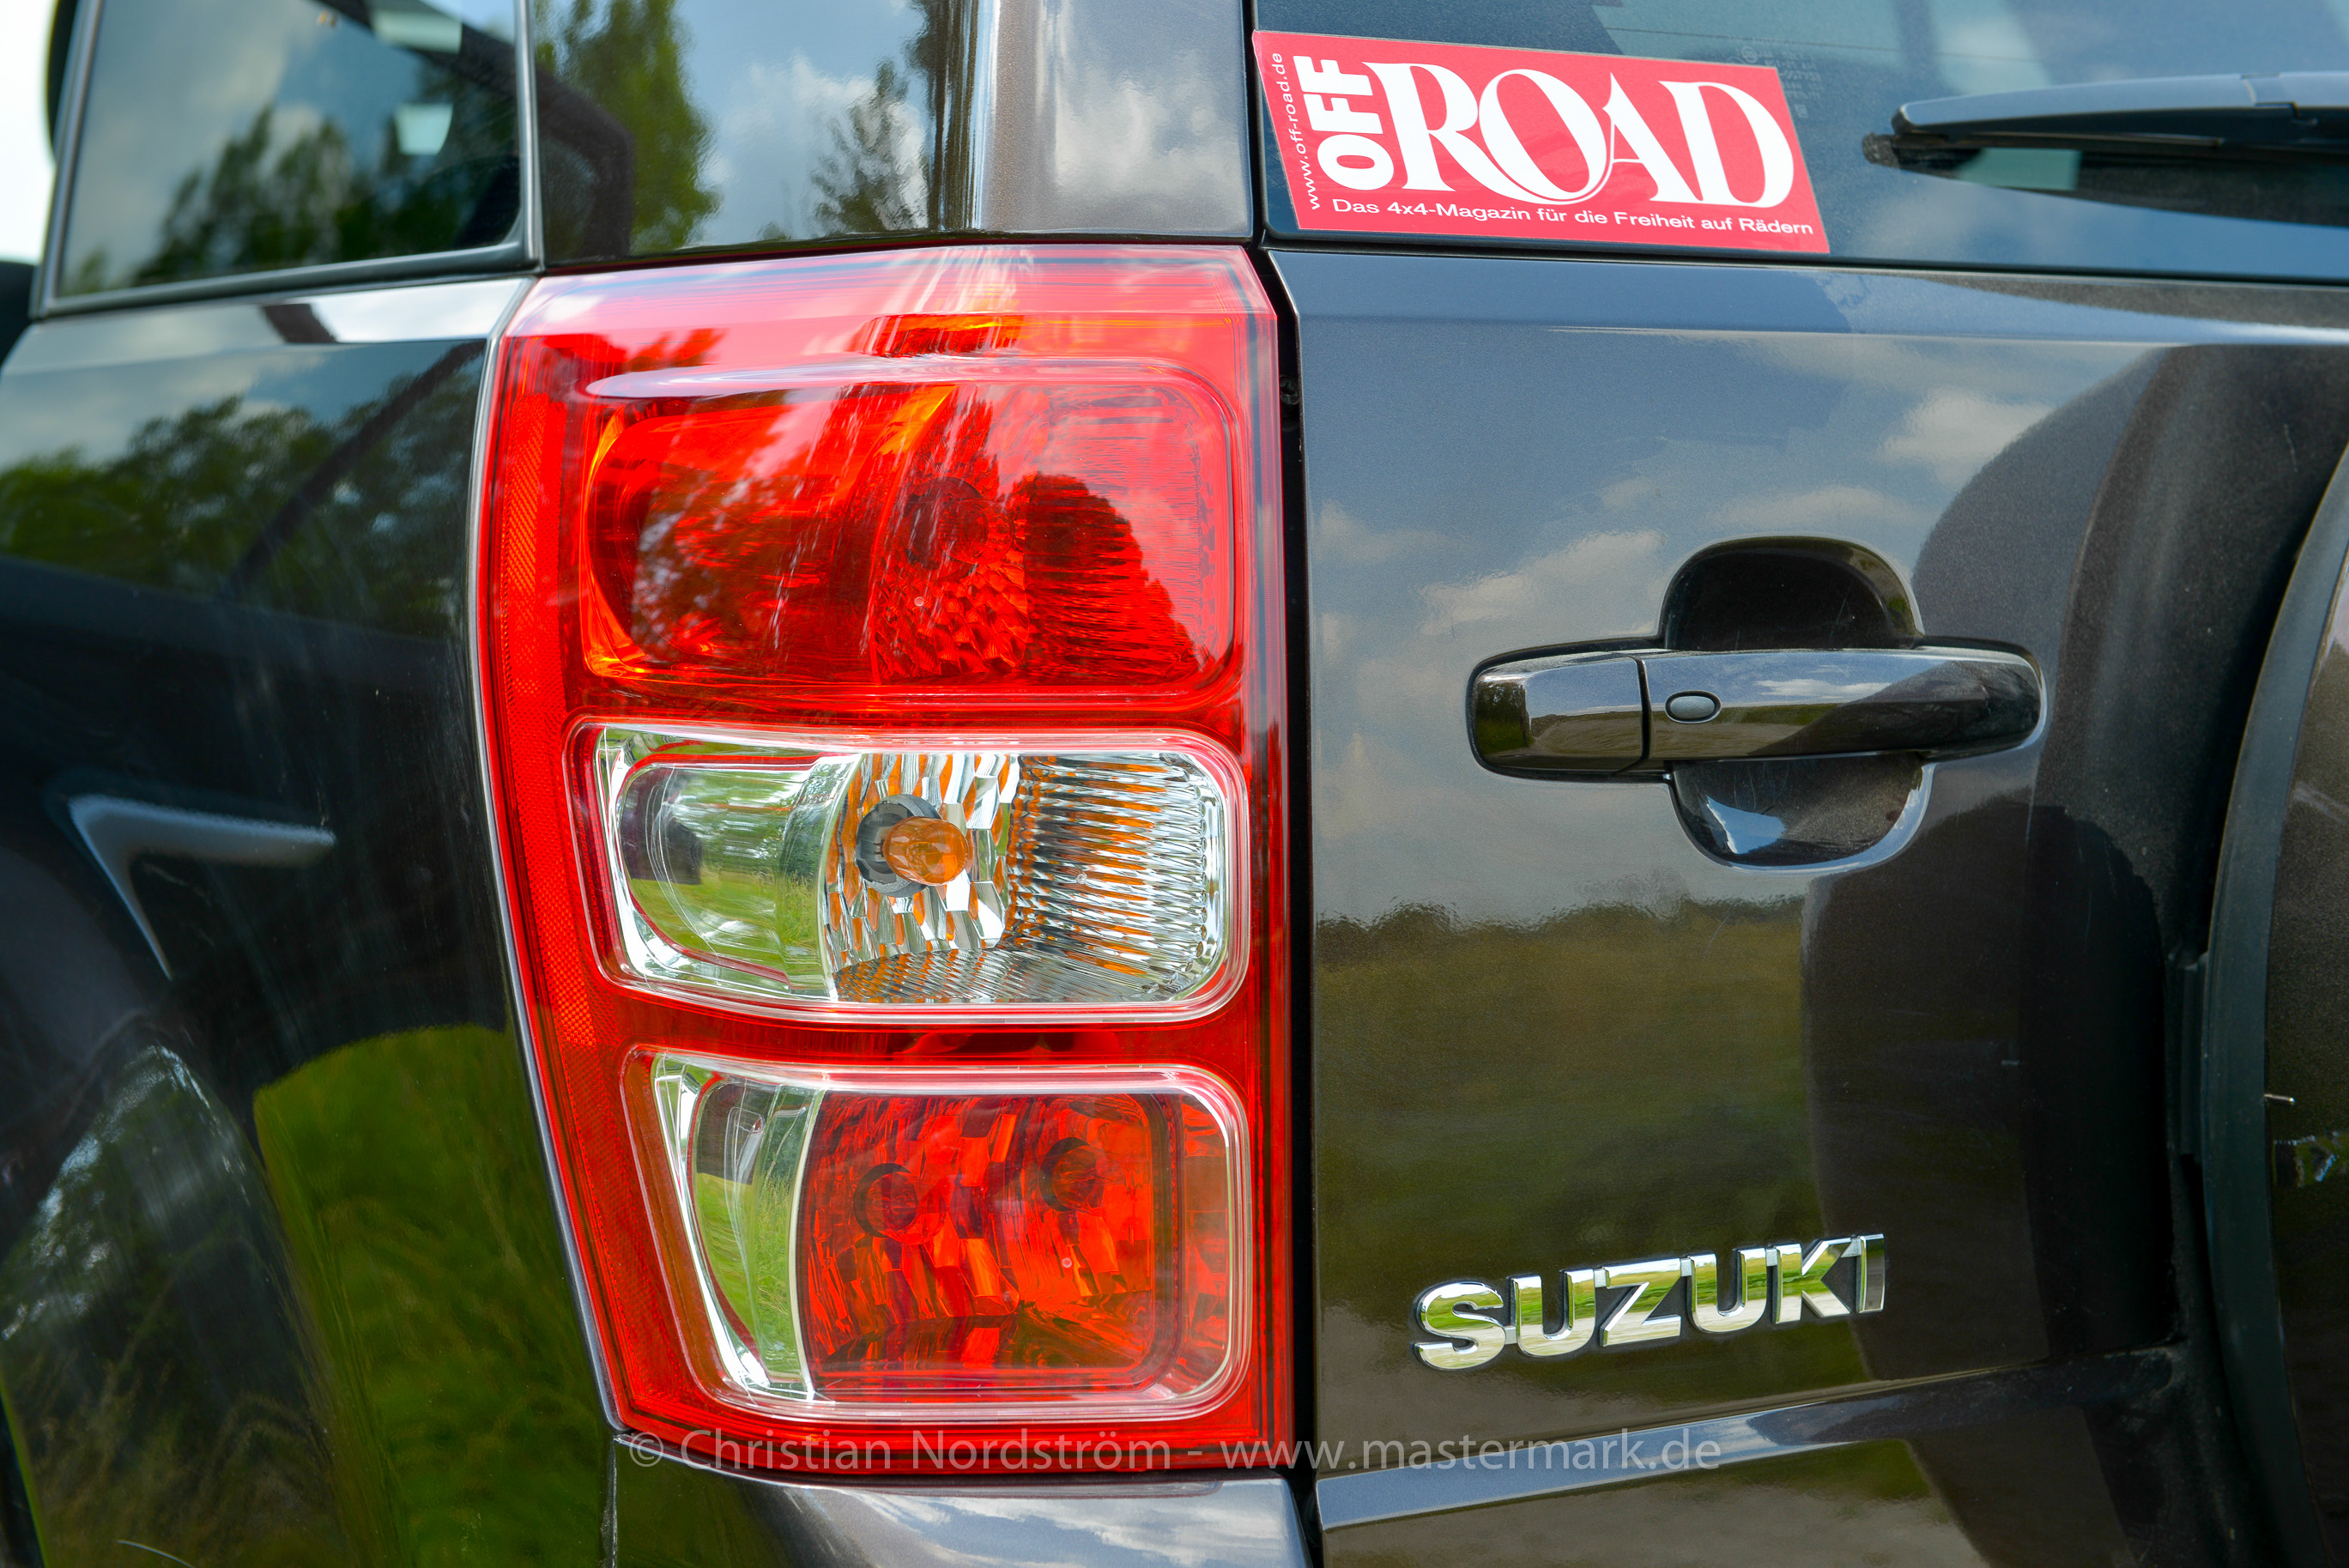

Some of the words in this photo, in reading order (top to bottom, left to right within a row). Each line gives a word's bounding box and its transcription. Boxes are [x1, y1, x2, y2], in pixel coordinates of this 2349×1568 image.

[1272, 52, 1321, 210] www.off-road.de
[1293, 55, 1394, 191] OFF
[1361, 61, 1795, 209] ROAD
[1332, 198, 1380, 214] Das
[1387, 202, 1530, 221] 4x4-Magazin
[1536, 208, 1567, 222] für
[1574, 210, 1607, 225] die
[1613, 211, 1695, 229] Freiheit
[1701, 217, 1734, 231] auf
[1739, 218, 1814, 235] Rädern
[1413, 1232, 1886, 1371] SUZUKI
